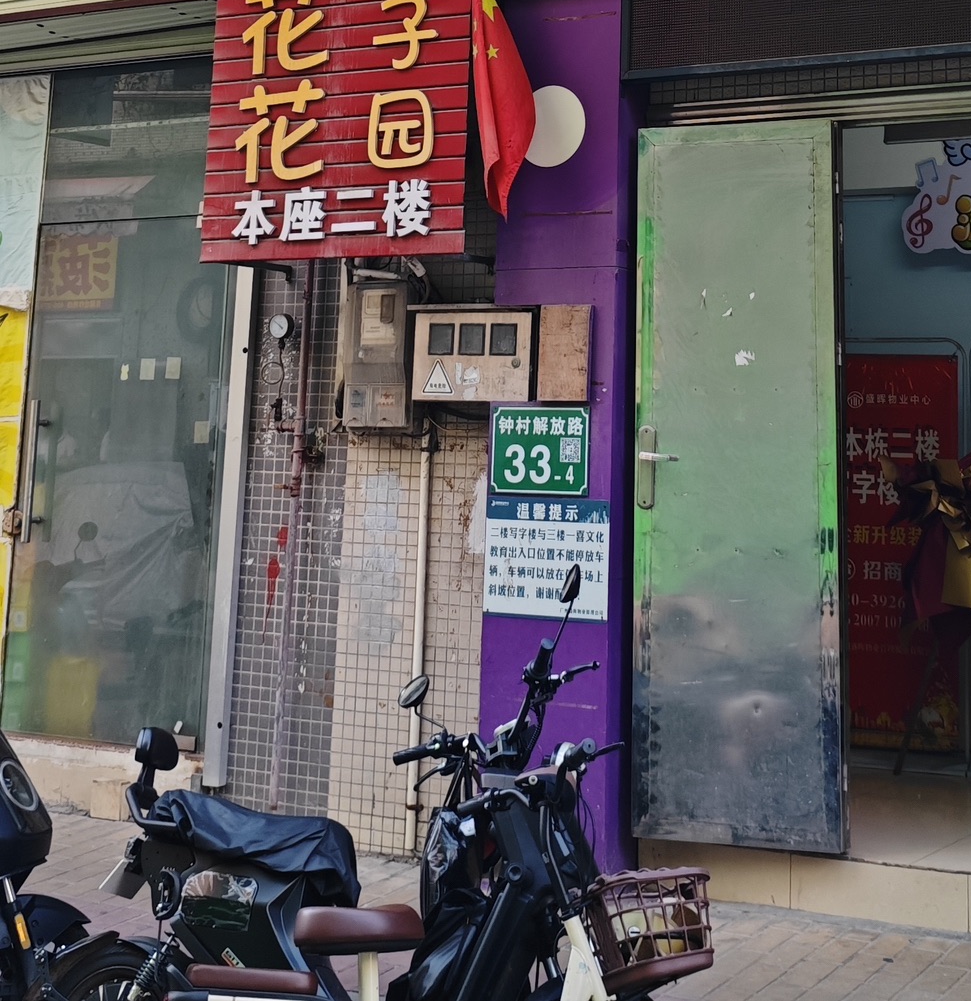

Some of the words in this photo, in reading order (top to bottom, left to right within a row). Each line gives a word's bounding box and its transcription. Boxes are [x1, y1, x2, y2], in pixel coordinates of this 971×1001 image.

[231, 179, 431, 246] 本座二楼
[498, 416, 584, 436] 钟村解放路
[846, 470, 901, 505] 字楼
[516, 503, 579, 521] 温馨提示
[490, 546, 604, 562] 教育出入口位置不能停放车
[489, 565, 603, 583] 辆，车辆可以放在场上
[848, 593, 905, 608] 0-3926
